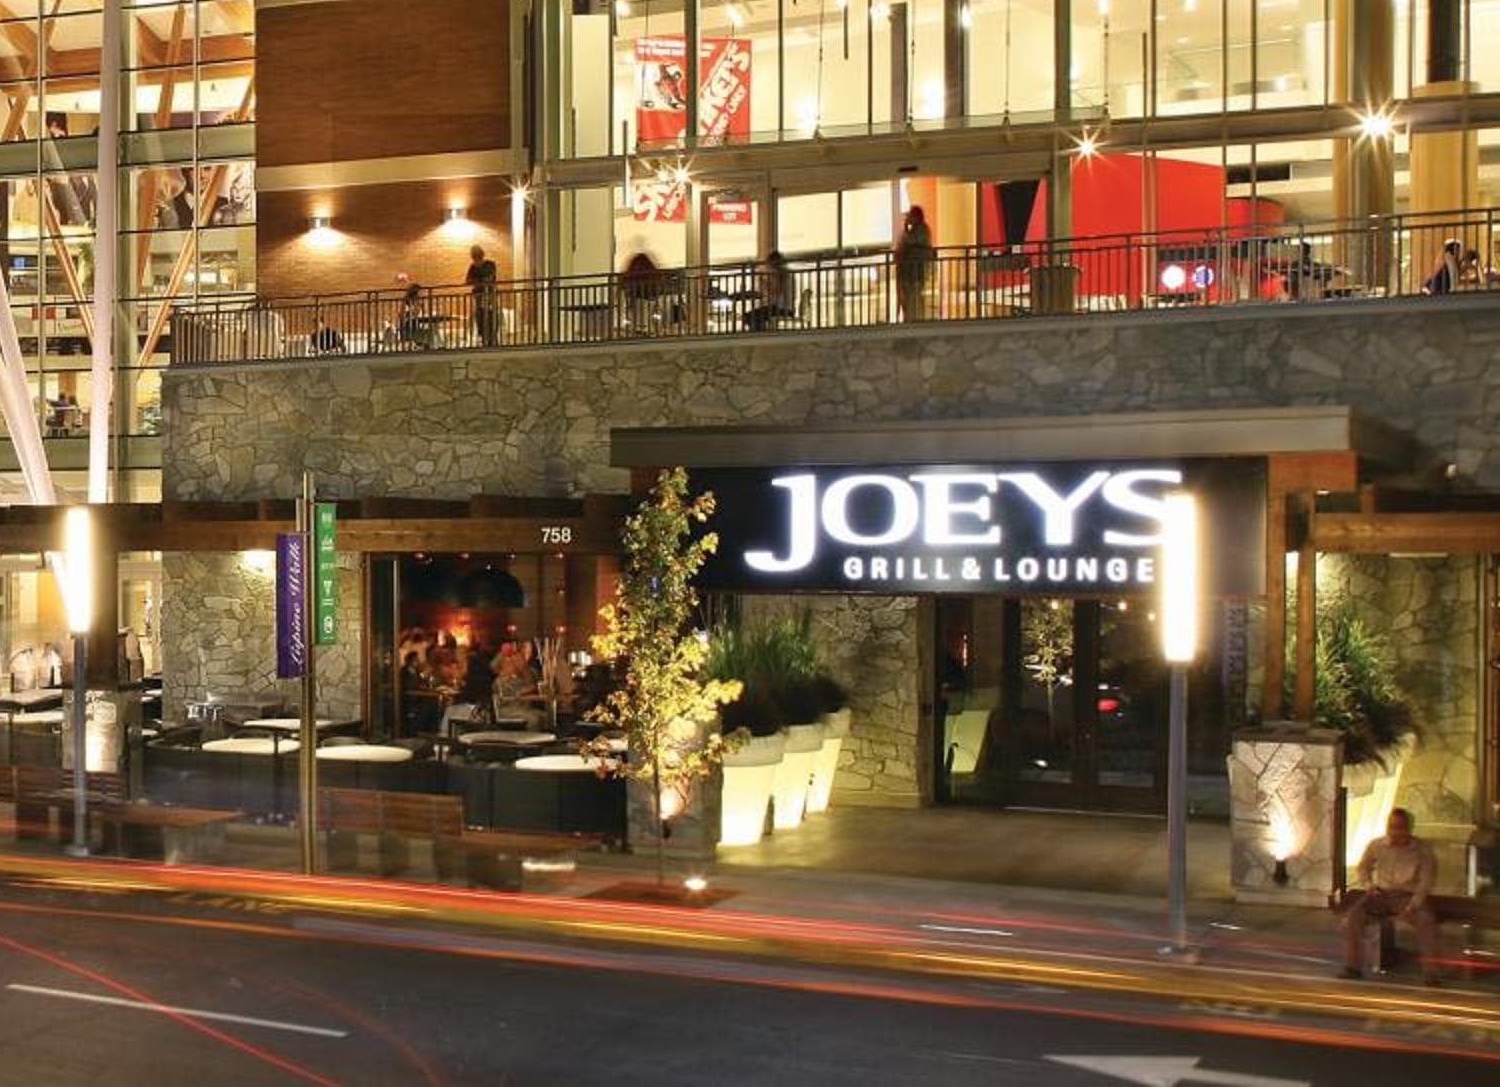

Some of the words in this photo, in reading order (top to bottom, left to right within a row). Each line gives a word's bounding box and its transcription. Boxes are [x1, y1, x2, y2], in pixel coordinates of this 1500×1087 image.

[743, 469, 1182, 573] JOEYS
[541, 526, 571, 544] 758
[843, 556, 951, 581] GRILL
[960, 556, 981, 581] &
[994, 557, 1155, 583] LOUNGE
